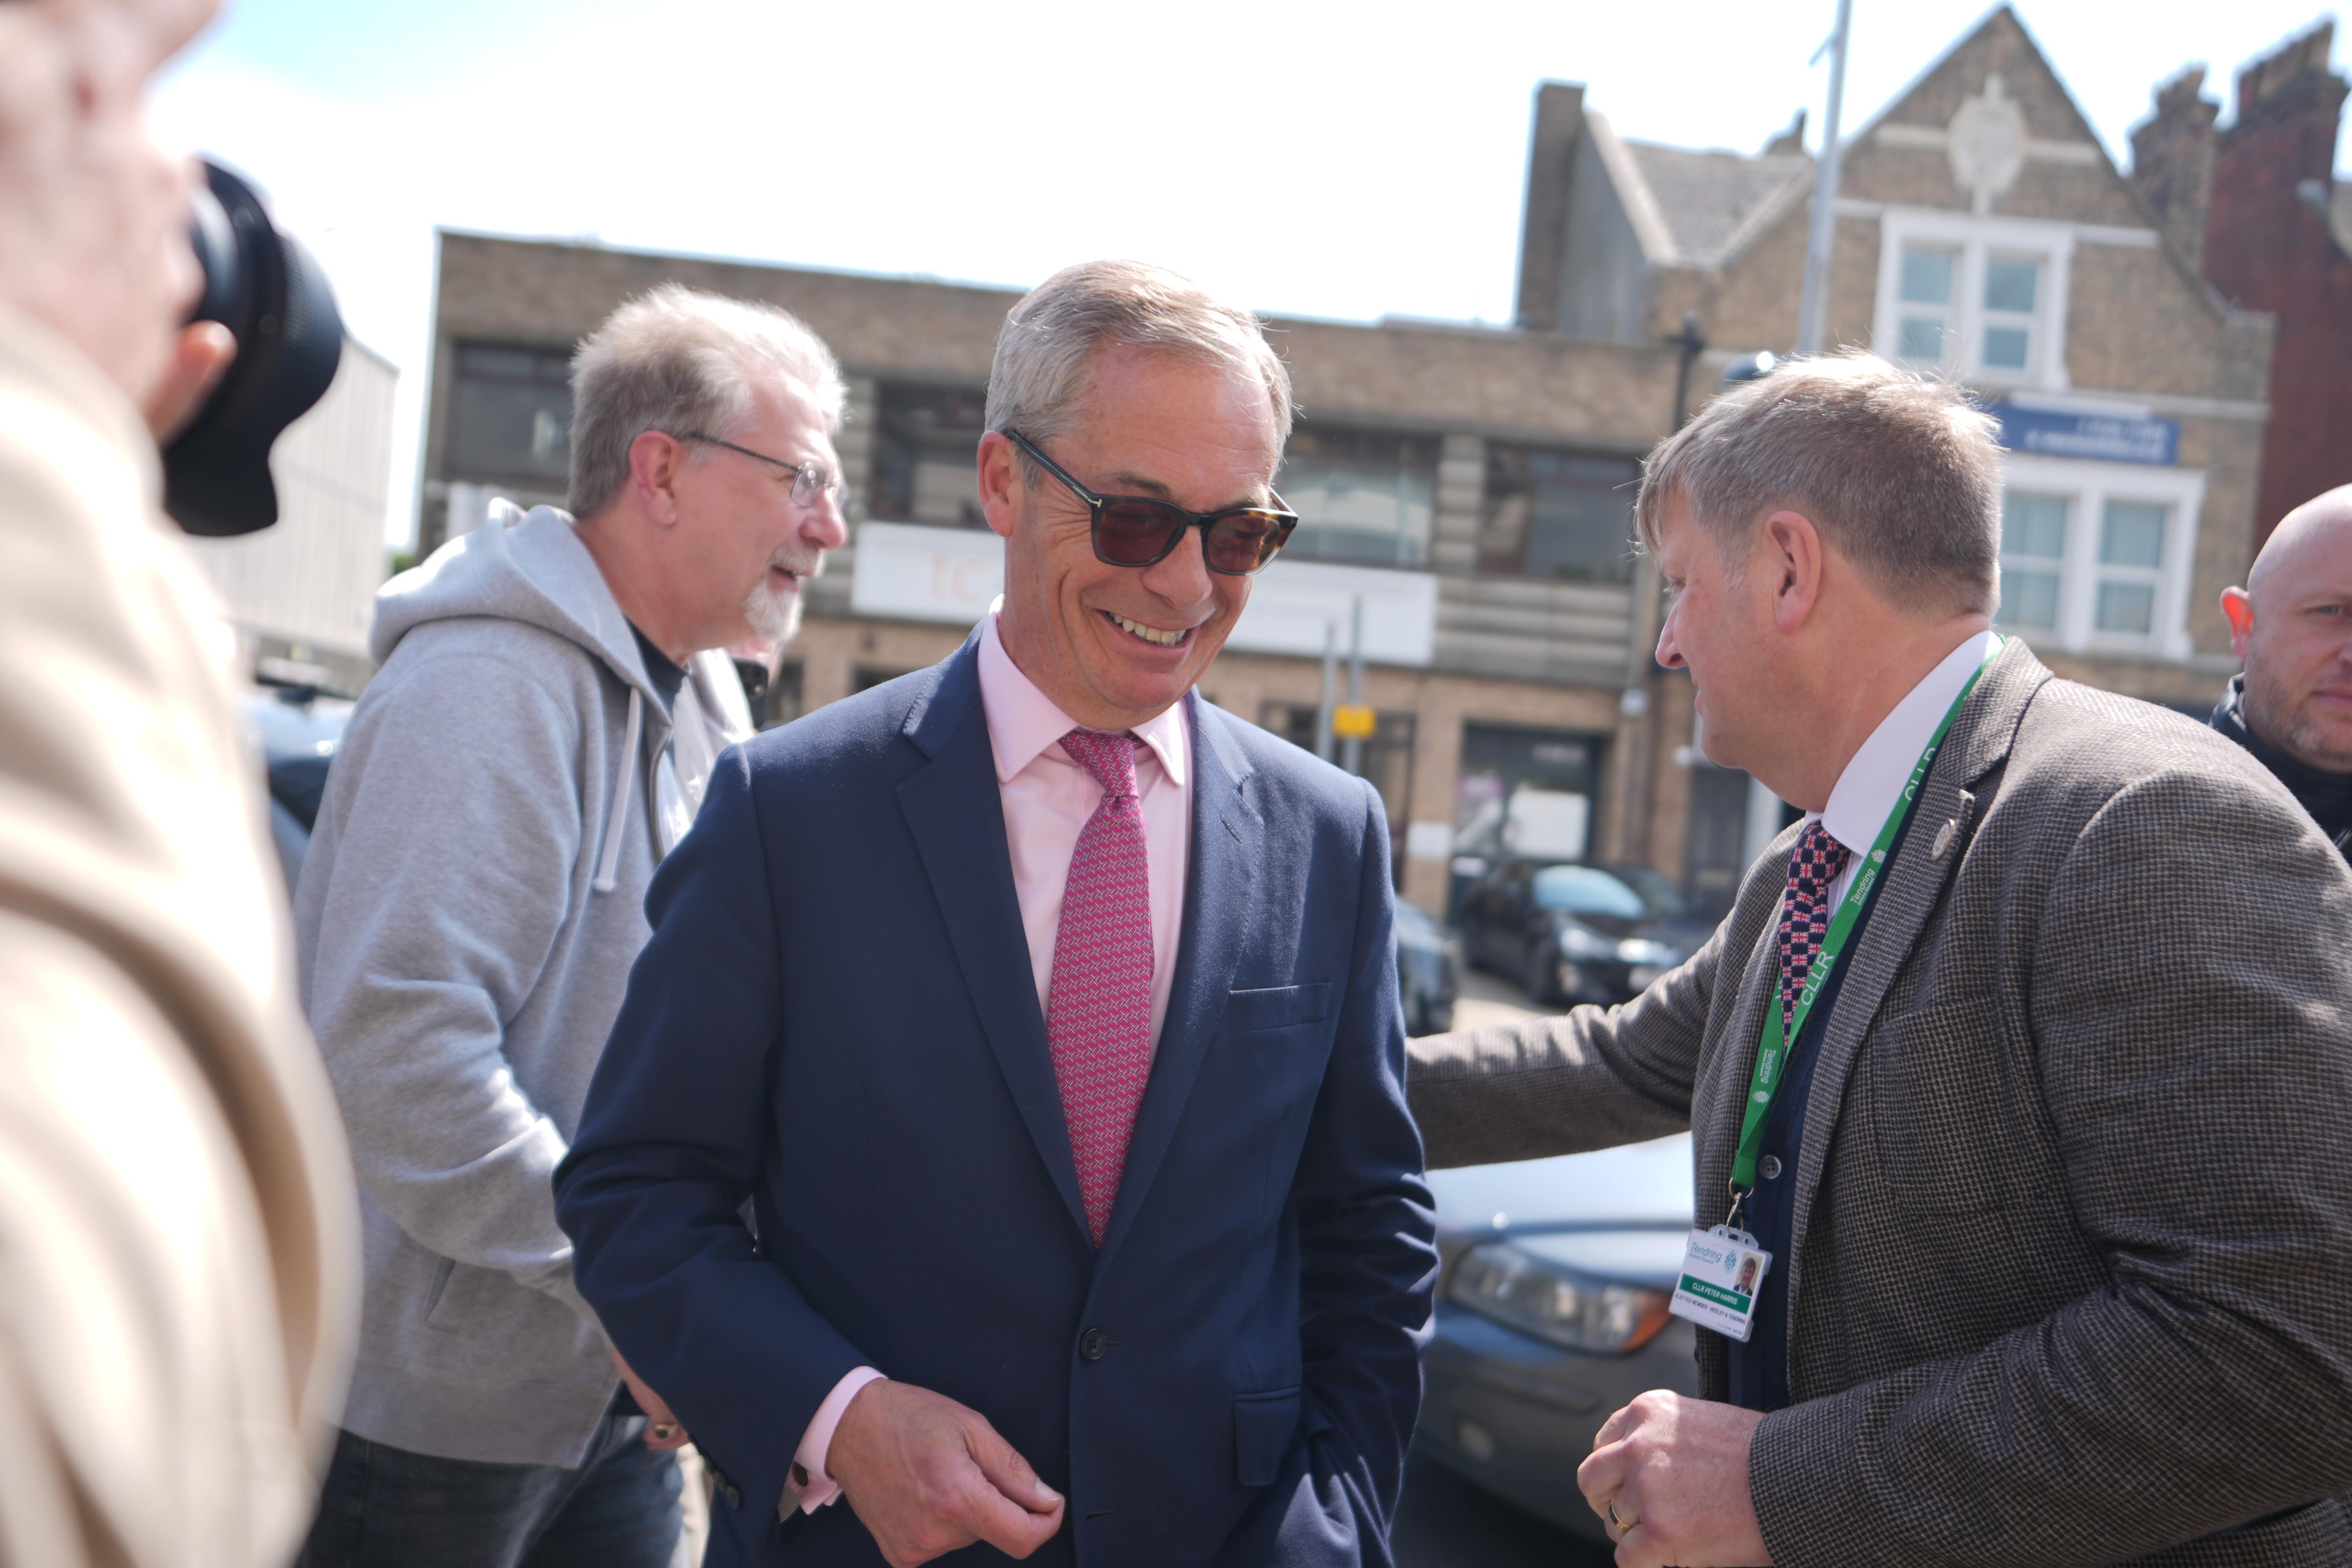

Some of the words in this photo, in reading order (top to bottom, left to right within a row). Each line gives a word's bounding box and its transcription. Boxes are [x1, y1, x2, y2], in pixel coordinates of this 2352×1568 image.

[1850, 868, 1875, 903] Tendring
[1802, 951, 1834, 1005] CLLR
[1760, 1049, 1776, 1084] Tendring
[1691, 1242, 1722, 1263] Tendring
[1675, 1293, 1692, 1303] ELECTED
[1692, 1299, 1708, 1310] MEMBER
[1710, 1307, 1725, 1318] WEELEY
[1729, 1314, 1746, 1325] TENDRING
[1692, 1282, 1704, 1292] CLLR
[1705, 1287, 1720, 1298] PETER
[1720, 1293, 1738, 1305] HARRIS
